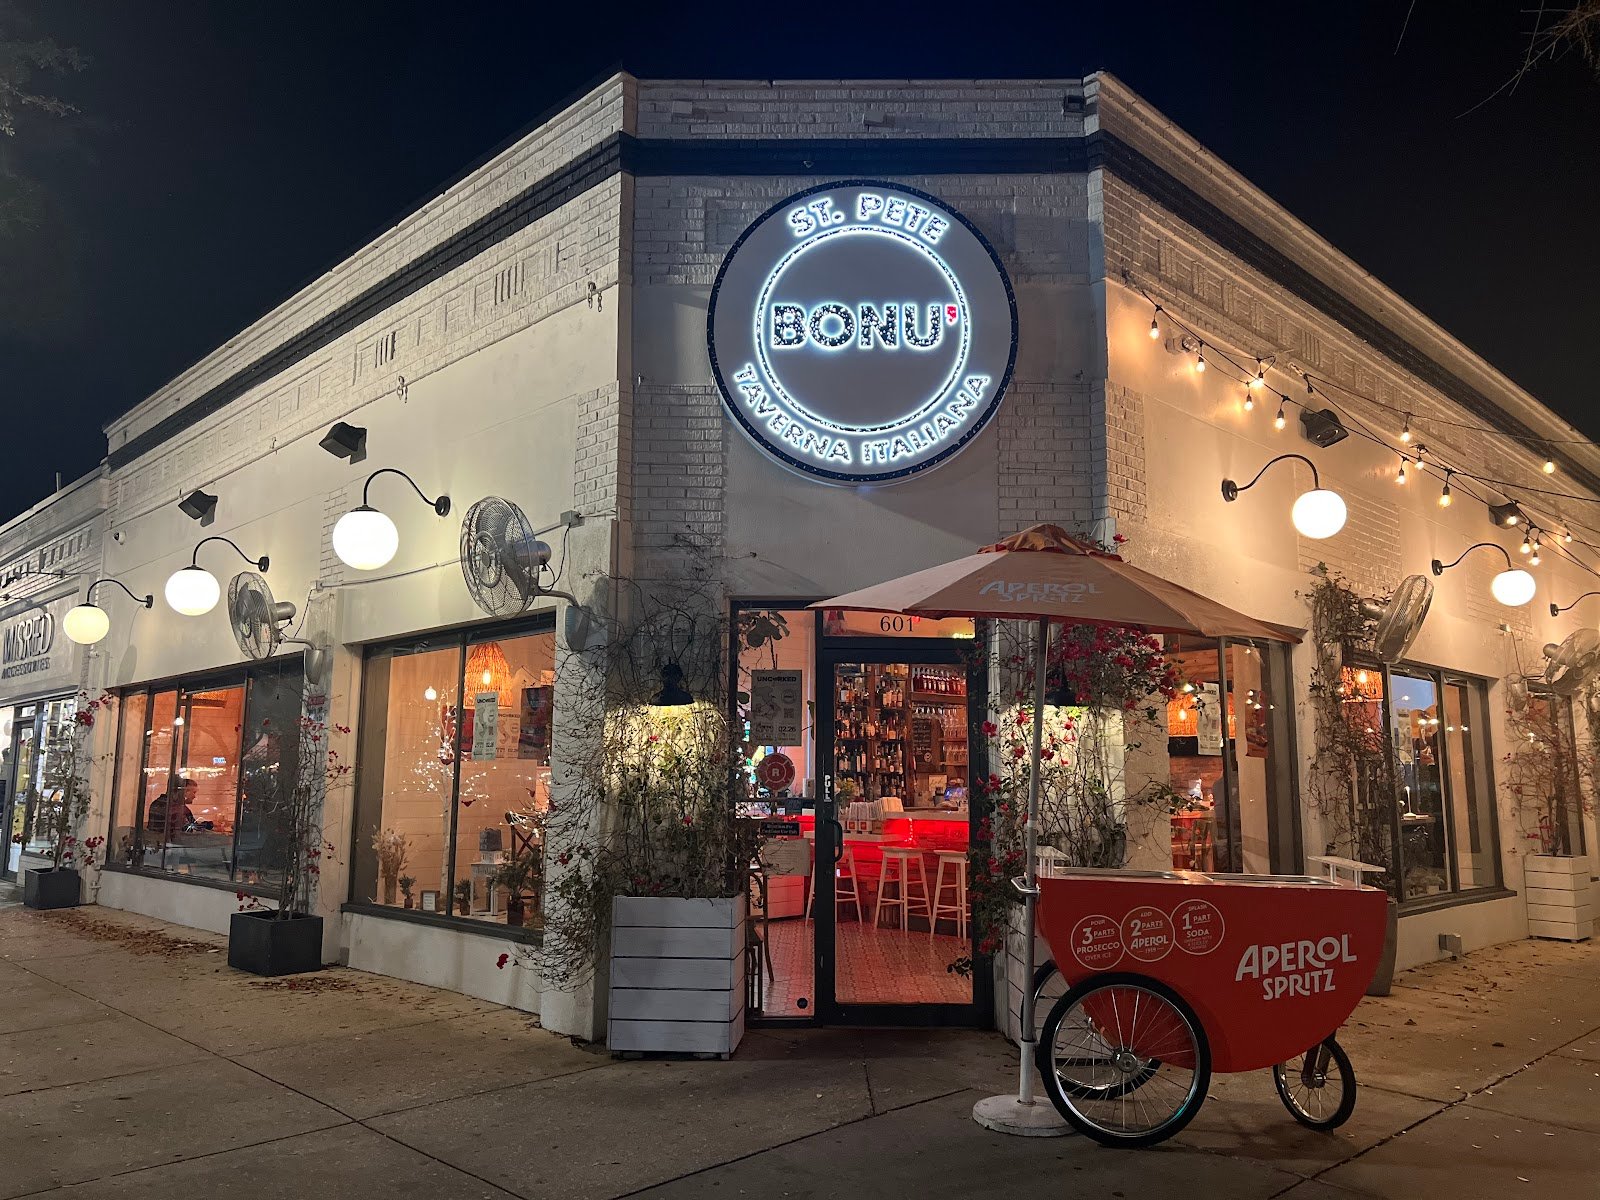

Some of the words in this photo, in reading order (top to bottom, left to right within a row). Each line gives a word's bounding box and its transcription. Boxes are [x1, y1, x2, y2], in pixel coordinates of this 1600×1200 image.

[789, 197, 844, 237] ST.
[857, 193, 949, 244] PETE
[734, 363, 852, 463] TAVERNA
[862, 375, 990, 463] ITALIANA
[979, 580, 1104, 594] APEROL
[880, 616, 915, 632] 601
[771, 768, 780, 777] R
[824, 774, 832, 802] PULL
[1130, 919, 1142, 937] 2
[1141, 920, 1163, 929] PARTS
[1182, 912, 1192, 930] 1
[1193, 914, 1211, 922] PART
[1081, 927, 1093, 945] 3
[1093, 928, 1116, 937] PARTS
[1130, 935, 1169, 950] APEROL
[1186, 929, 1210, 938] SODA
[1077, 942, 1120, 954] PROSECCO
[1235, 933, 1358, 982] APEROL
[1262, 968, 1336, 1001] SPRITZ
